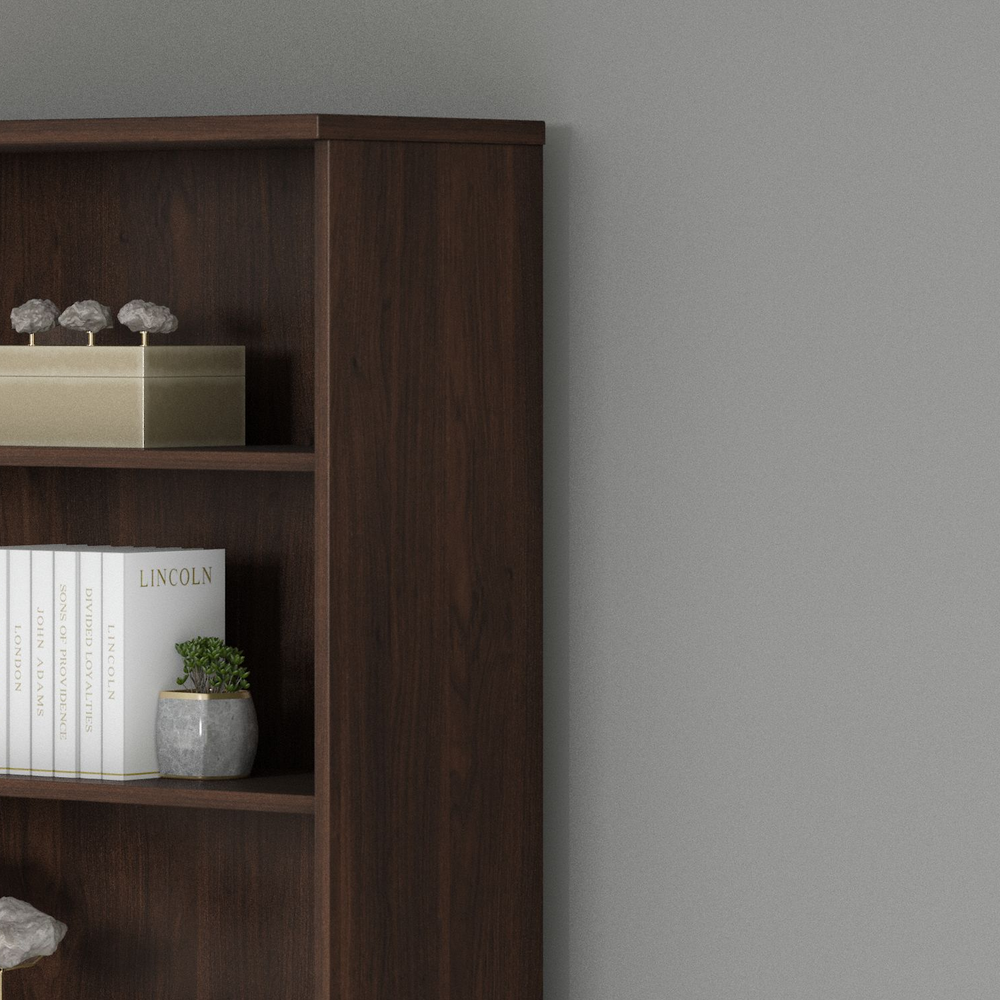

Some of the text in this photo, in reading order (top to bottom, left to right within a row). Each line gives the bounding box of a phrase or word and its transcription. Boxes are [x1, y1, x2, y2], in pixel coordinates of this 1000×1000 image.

[139, 566, 213, 588] LINCOLN
[14, 625, 22, 692] LONDON
[36, 607, 45, 717] JOHN ADAMS
[59, 583, 67, 740] SONS OF PROVIDENCE
[85, 588, 93, 733] DIVIDED LOYALTIES
[107, 624, 116, 700] LINCOLN
